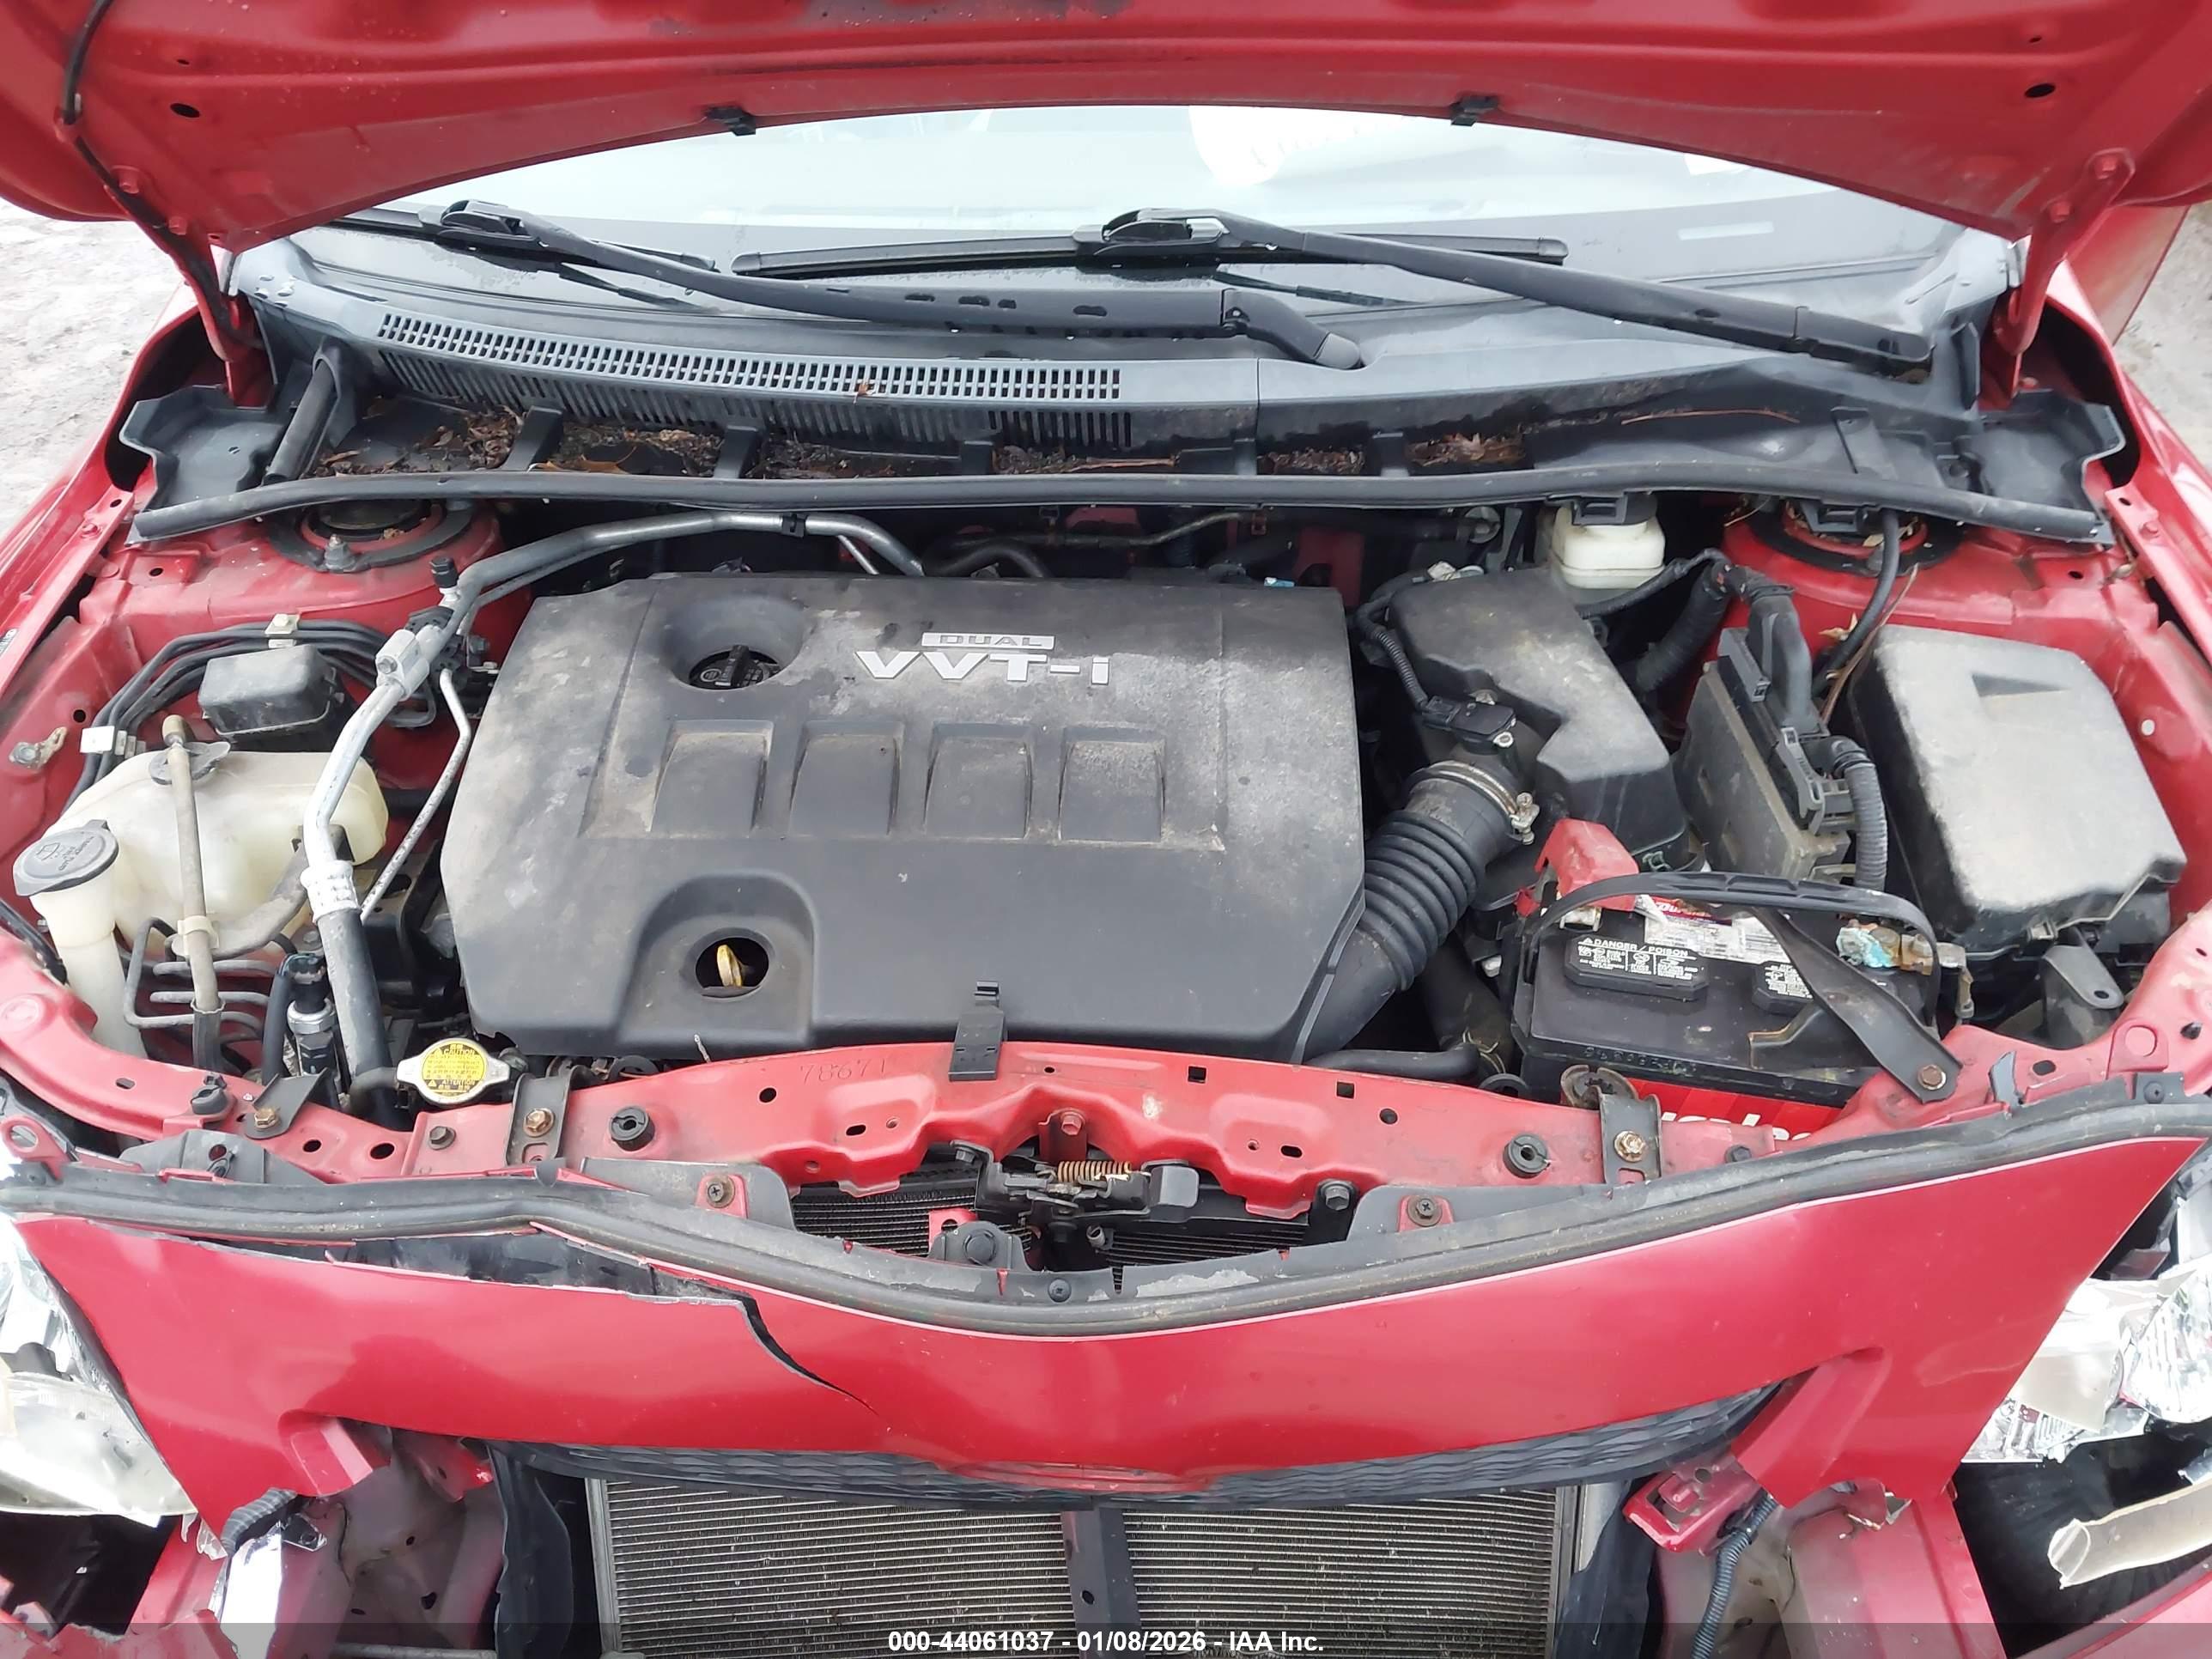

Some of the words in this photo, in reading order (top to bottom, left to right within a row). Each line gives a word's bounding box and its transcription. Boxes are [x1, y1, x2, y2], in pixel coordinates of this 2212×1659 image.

[939, 634, 1042, 647] DUAL
[854, 650, 1109, 686] VVT-i
[1594, 938, 1638, 951] DANGER
[1648, 945, 1689, 957] POISON
[443, 1048, 475, 1056] CAUTION
